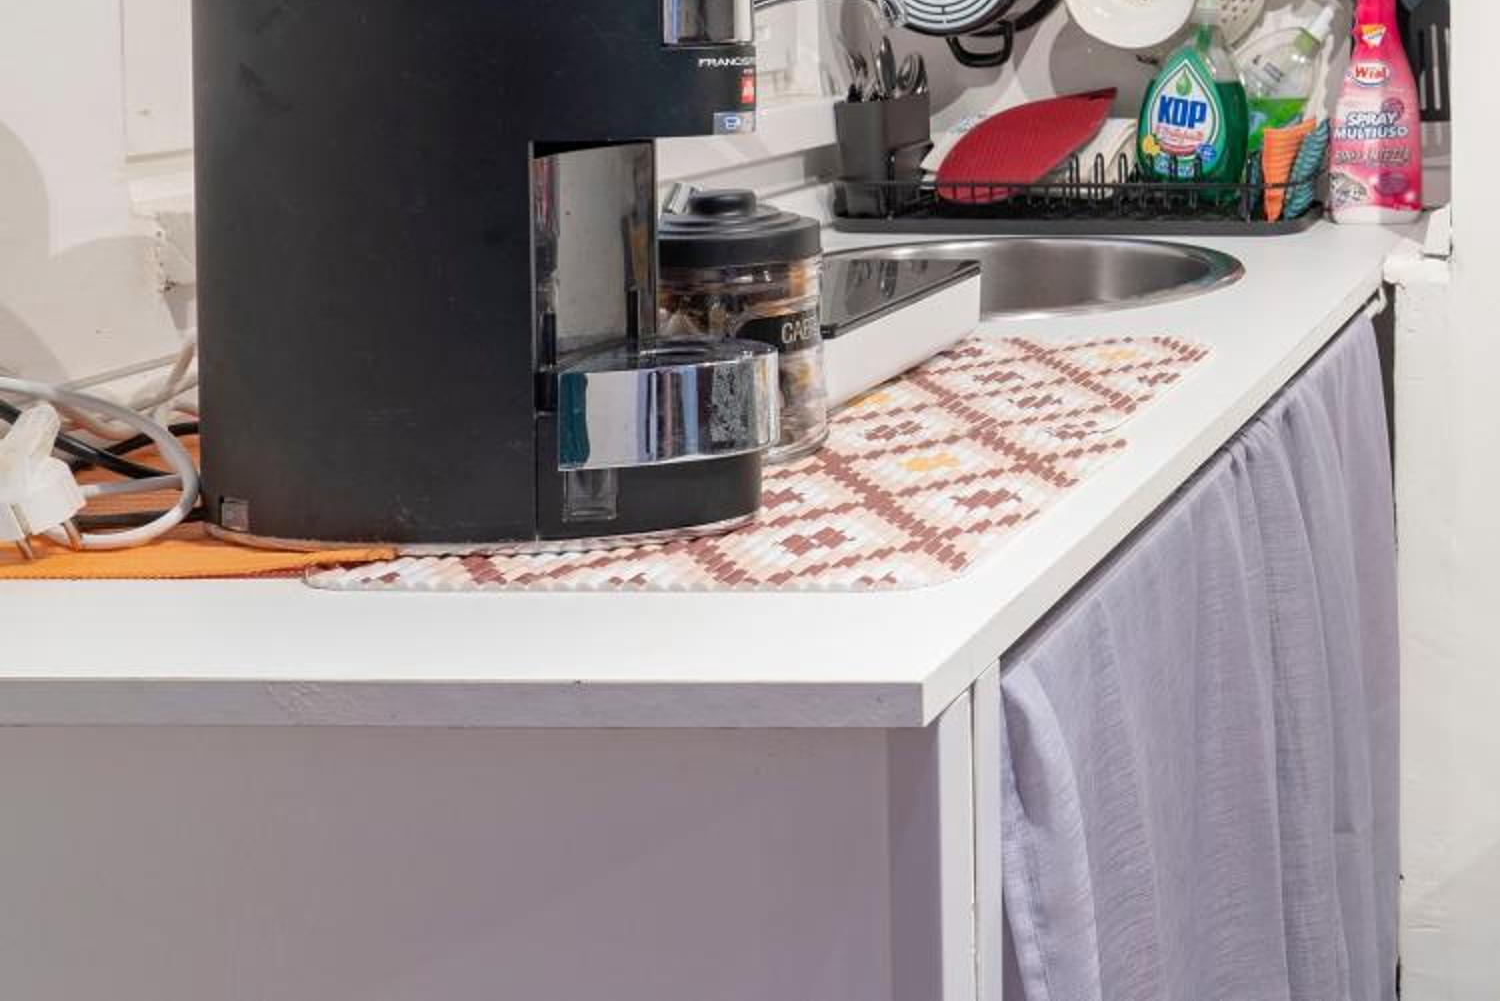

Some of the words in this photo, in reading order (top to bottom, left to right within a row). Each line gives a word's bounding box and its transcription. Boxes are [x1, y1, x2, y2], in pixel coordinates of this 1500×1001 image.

[1158, 94, 1207, 129] KOP
[1347, 111, 1398, 126] SPRAY
[1333, 125, 1409, 140] MULTIUSO
